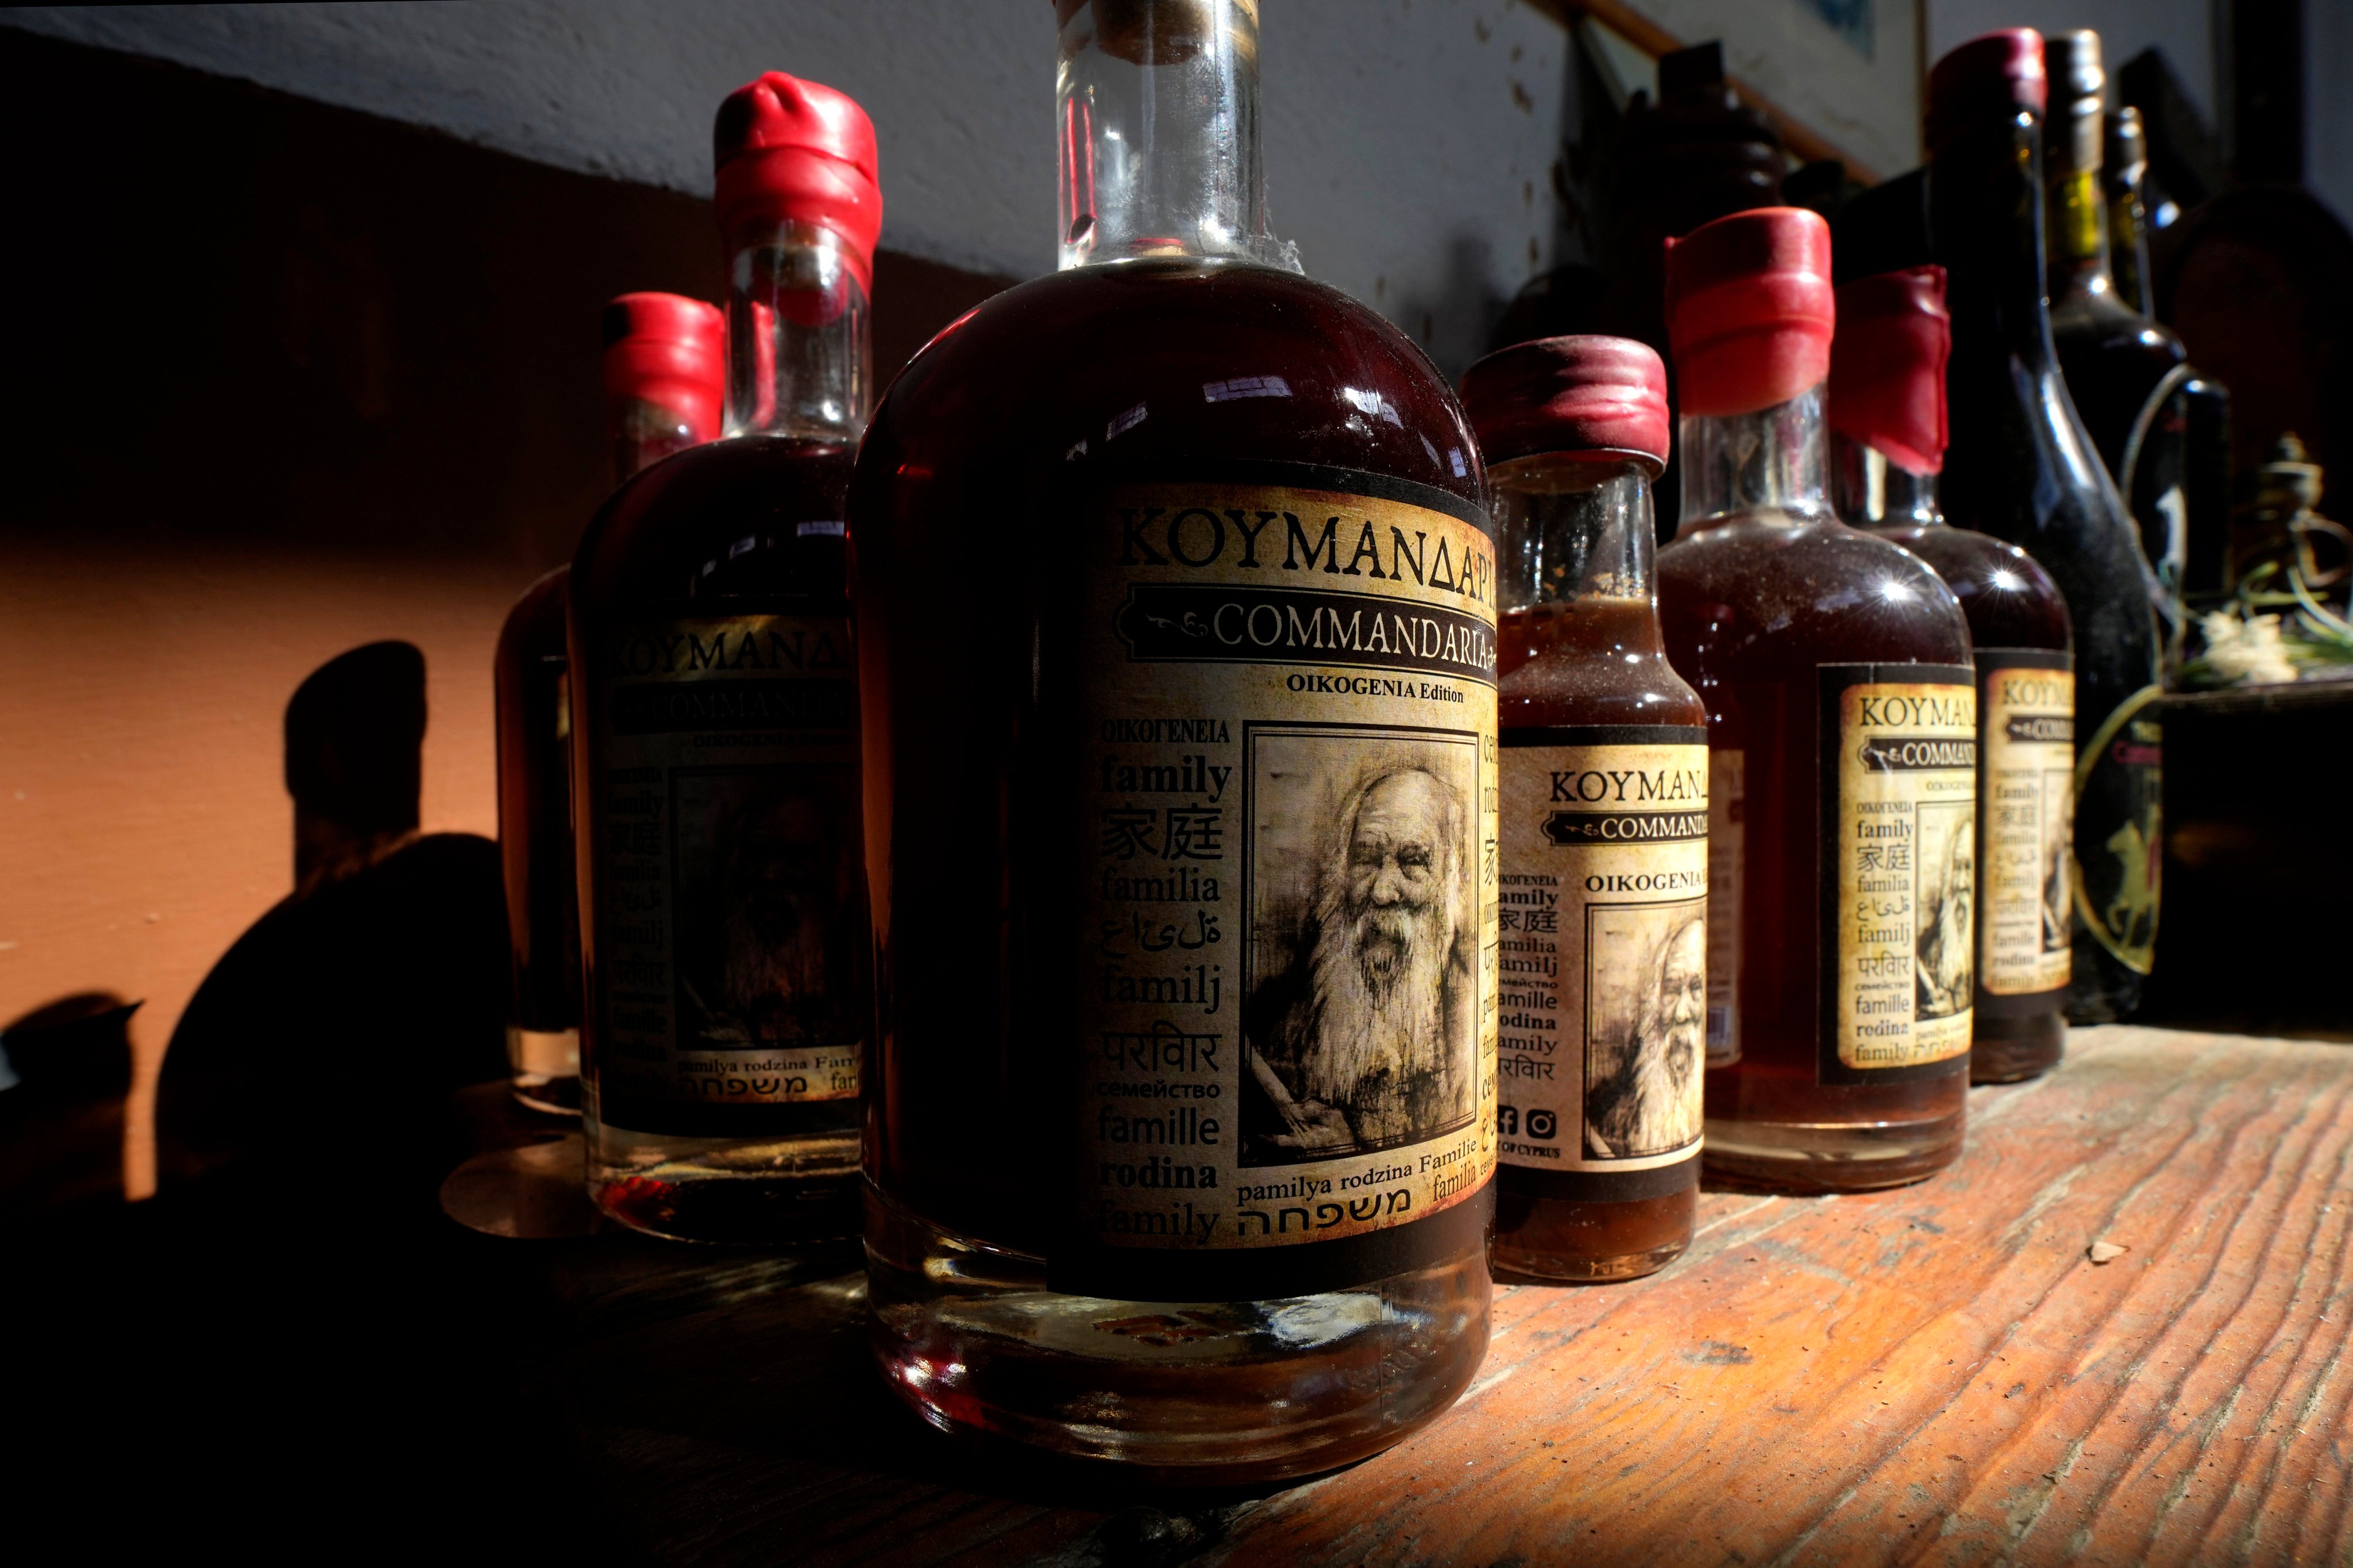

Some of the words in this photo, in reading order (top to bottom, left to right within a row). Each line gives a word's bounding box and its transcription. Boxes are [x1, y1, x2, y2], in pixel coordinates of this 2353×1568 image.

[1115, 507, 1495, 611] ΚΟΥΜΑΝΔΑΡΙ
[1213, 602, 1488, 670] COMMANDARIA
[1286, 673, 1417, 698] OIKOGENIA
[1419, 682, 1464, 704] Edition
[1100, 755, 1232, 803] family
[1101, 802, 1223, 861] 家庭
[1857, 820, 1914, 842] family
[1857, 843, 1910, 871] 家庭
[1100, 866, 1221, 902] familia
[1585, 871, 1700, 892] OIKOGENIA
[1858, 875, 1909, 892] familia
[1498, 889, 1559, 909] amily
[1498, 937, 1557, 953] amilia
[1858, 922, 1910, 947] familj
[1499, 956, 1557, 978] amilj
[1101, 964, 1220, 1014] familj
[1498, 991, 1557, 1009] amille
[1856, 993, 1910, 1014] famille
[1499, 1013, 1557, 1030] odina
[1856, 1019, 1909, 1037] rodina
[1498, 1035, 1557, 1056] amily
[745, 1059, 808, 1072] rodzina
[1096, 1079, 1221, 1099] семейство
[1097, 1104, 1220, 1145] famille
[1517, 1144, 1561, 1158] CYPRUS
[1099, 1156, 1218, 1189] rodina
[1236, 1176, 1332, 1207] pamilya
[1340, 1163, 1412, 1190] rodzina
[1419, 1140, 1477, 1173] Familie
[1432, 1160, 1477, 1203] familia
[1098, 1199, 1220, 1246] family
[1237, 1188, 1411, 1236] משפחה
